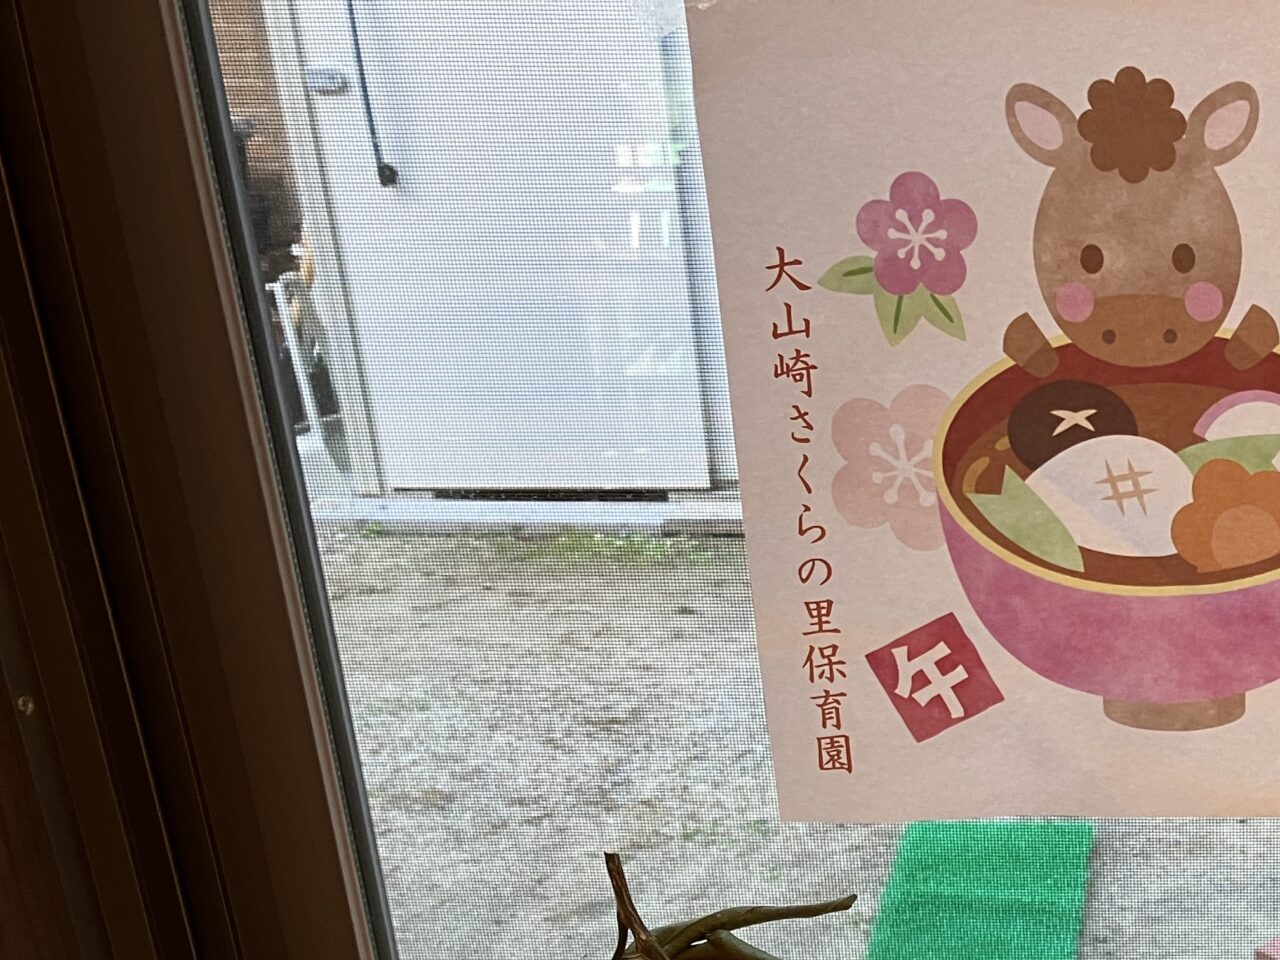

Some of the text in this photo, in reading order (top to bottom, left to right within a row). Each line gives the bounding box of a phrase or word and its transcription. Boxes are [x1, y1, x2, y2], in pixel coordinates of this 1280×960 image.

[764, 246, 853, 774] 大山崎さくらの里保育園
[893, 640, 969, 719] 午
